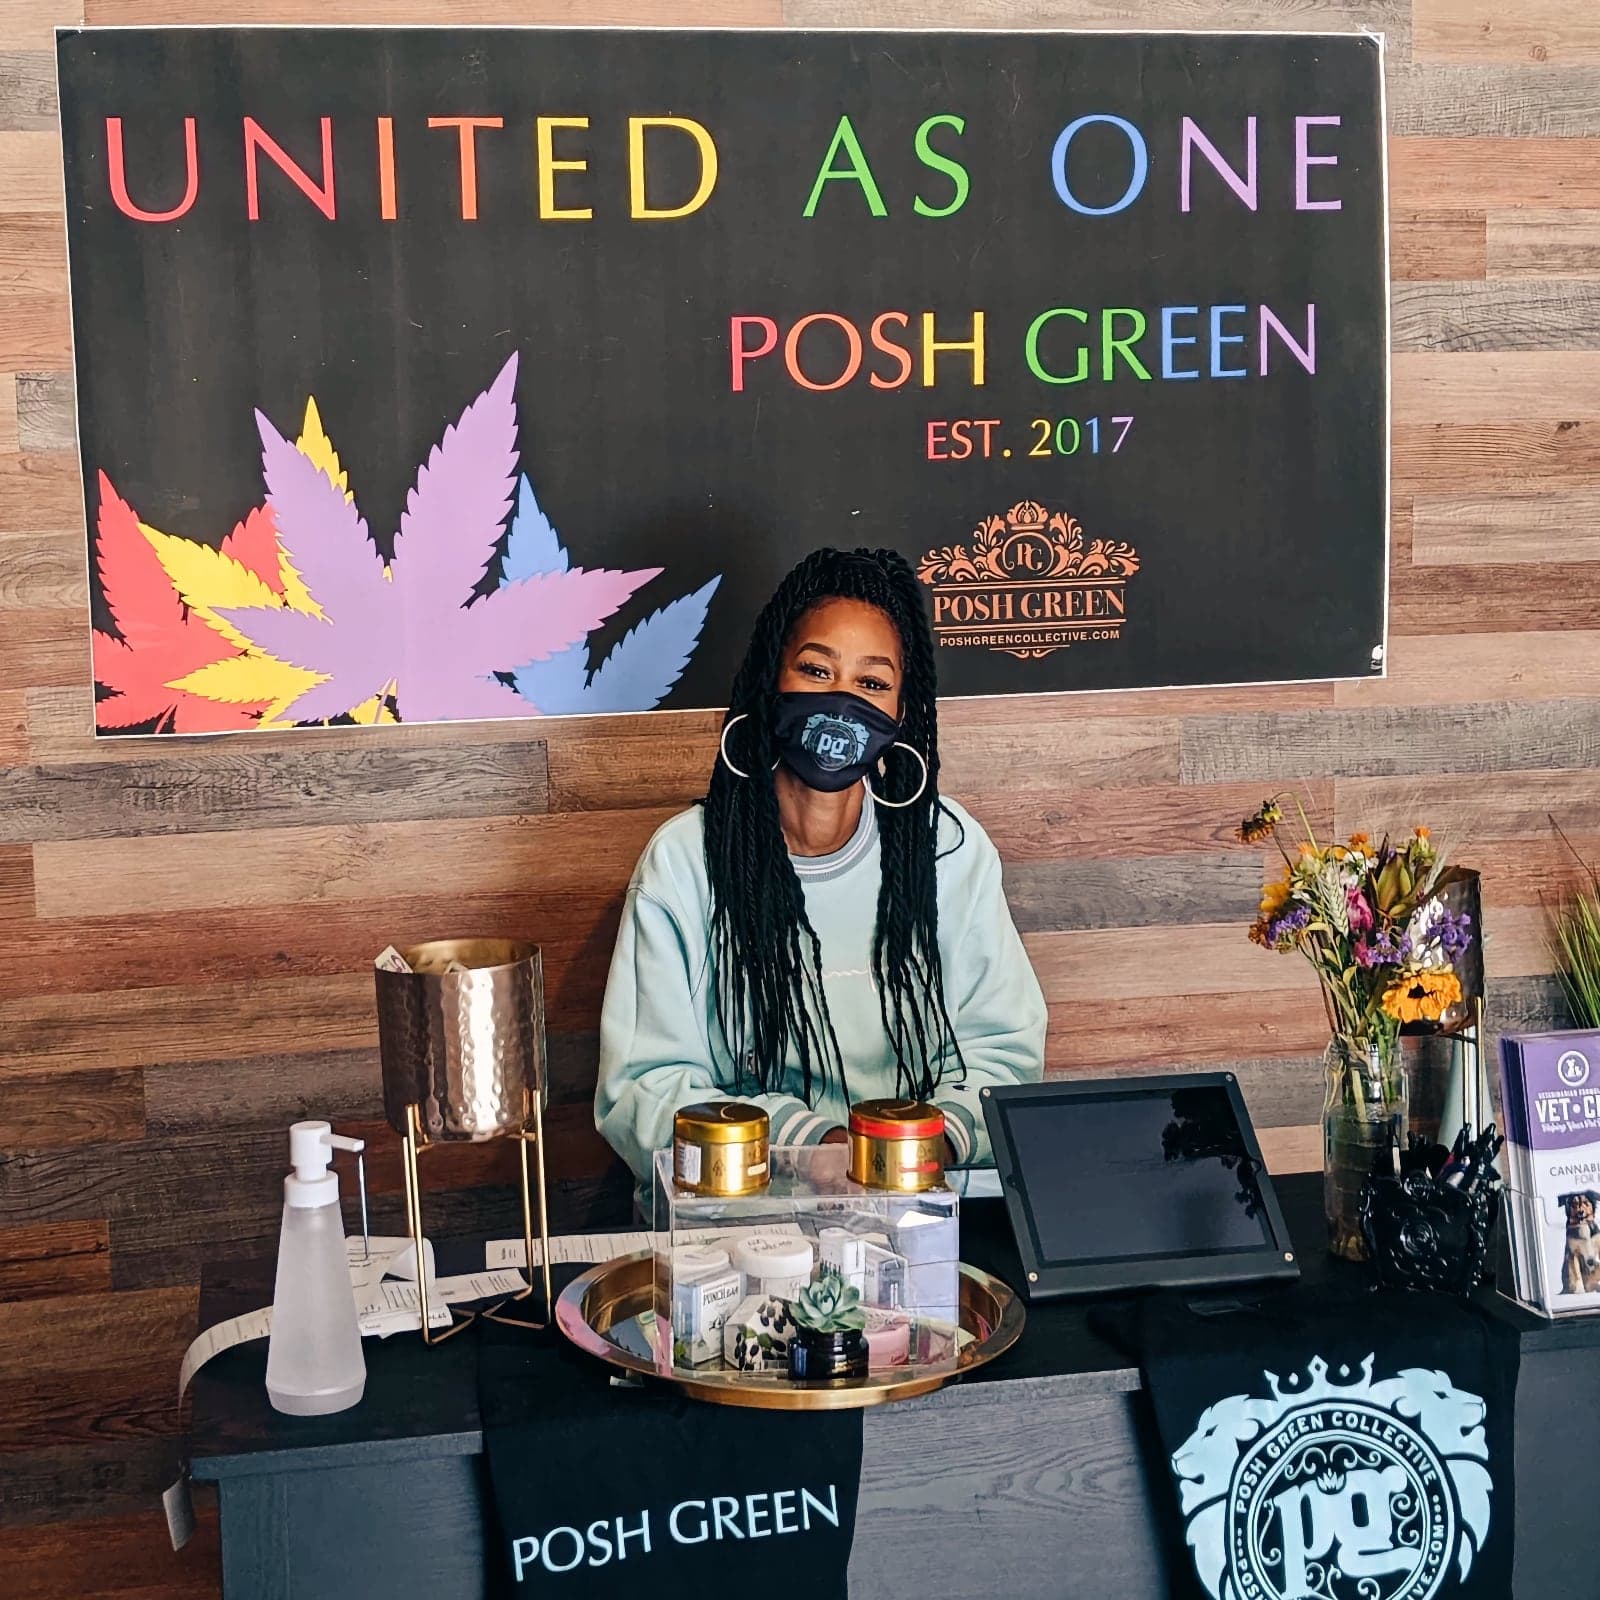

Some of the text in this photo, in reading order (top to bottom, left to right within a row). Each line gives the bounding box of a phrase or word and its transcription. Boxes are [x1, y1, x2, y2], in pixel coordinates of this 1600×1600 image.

[106, 113, 1342, 222] UNITED AS ONE
[730, 303, 1318, 392] POSH GREEN
[926, 416, 1134, 460] EST. 2017
[933, 589, 1126, 623] POSH GREEN
[938, 629, 1120, 648] POSHGREENCOLLECTIVE.COM
[816, 733, 850, 761] pg
[1237, 1411, 1437, 1514] POSH GREEN COLLECTIVE
[513, 1484, 840, 1582] POSH GREEN
